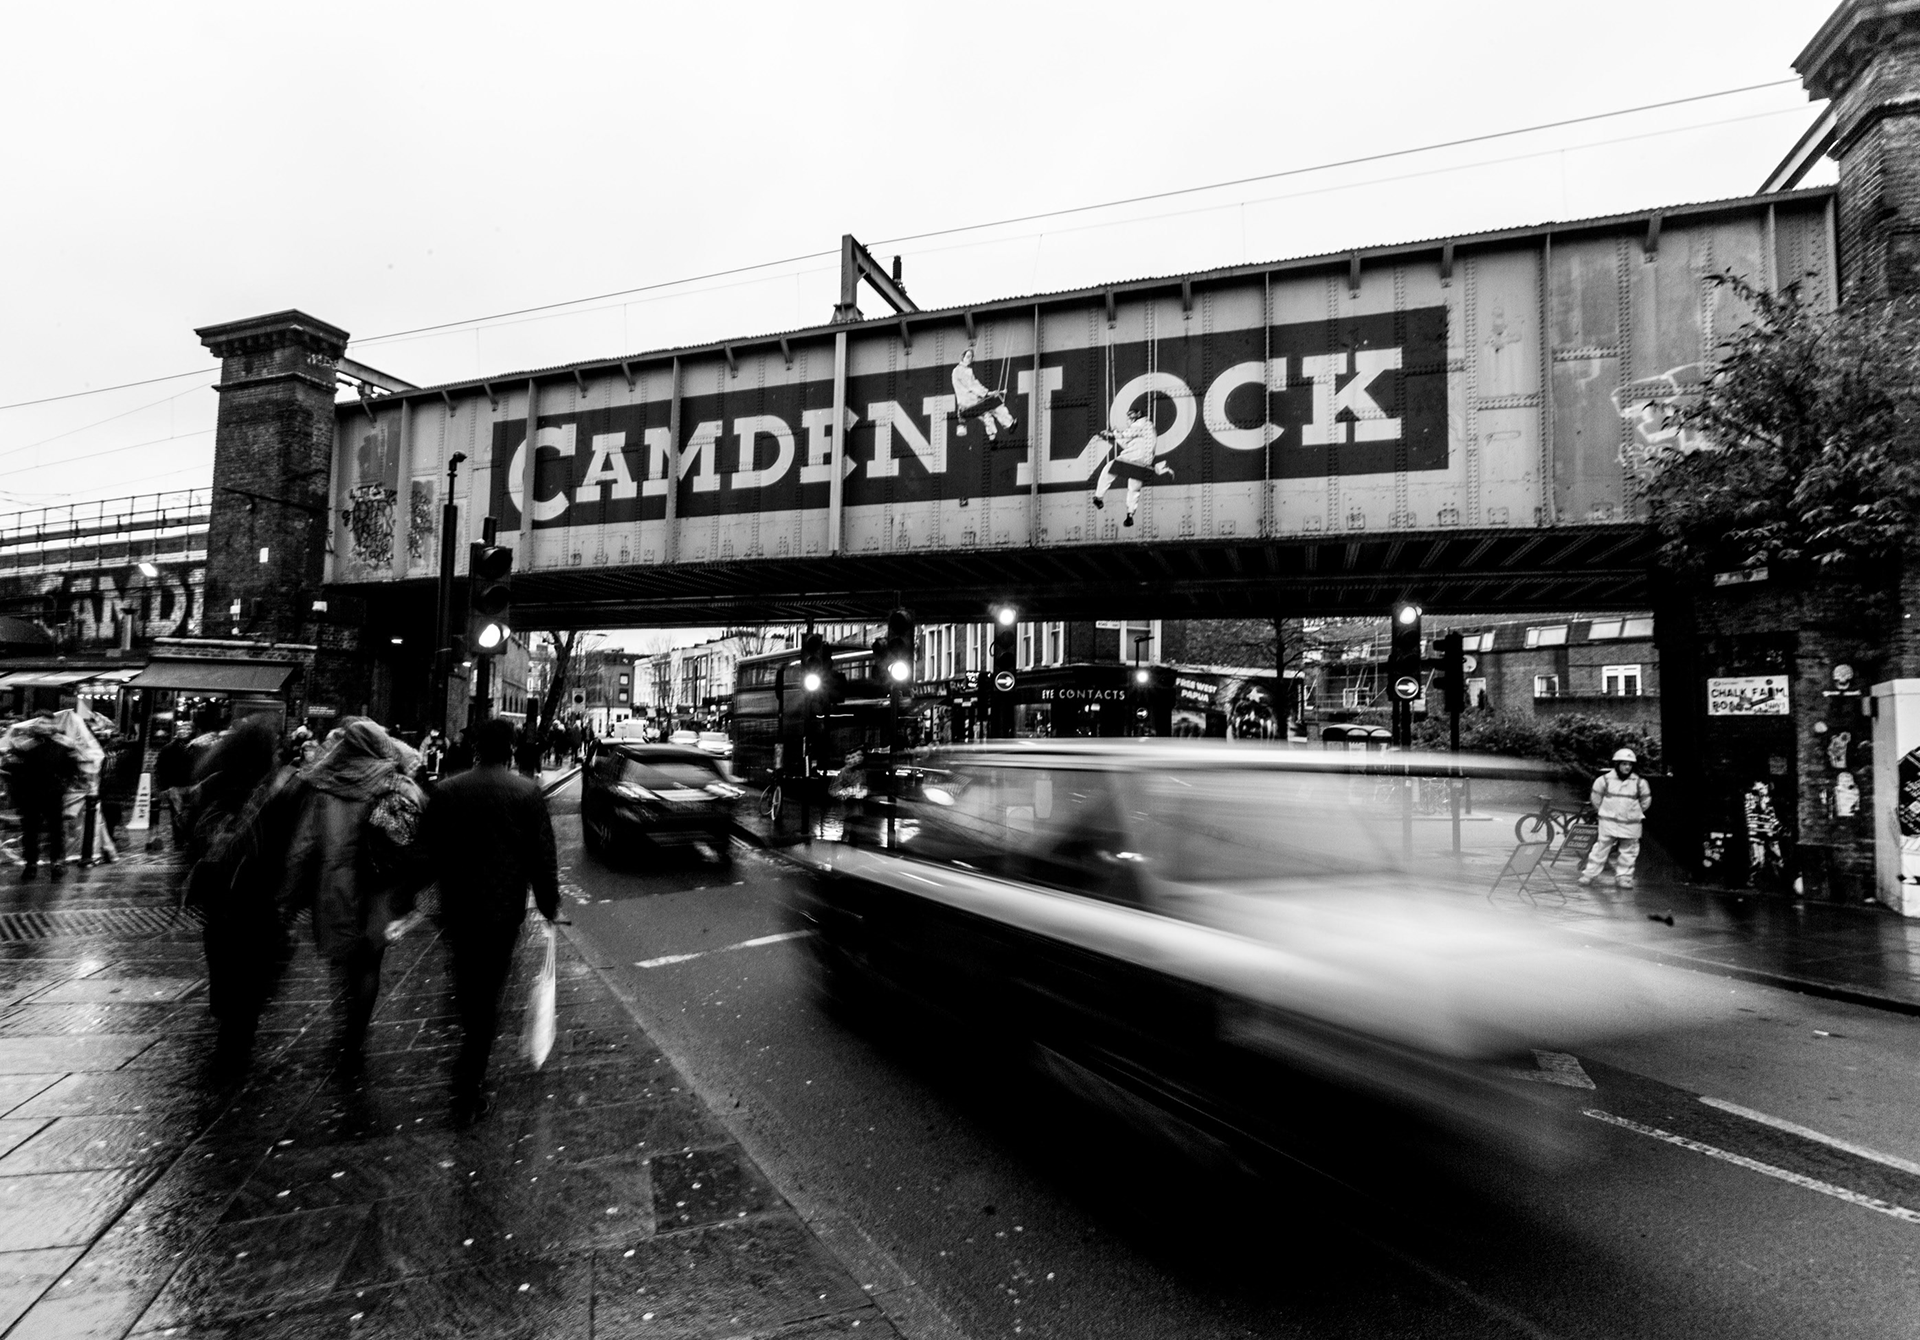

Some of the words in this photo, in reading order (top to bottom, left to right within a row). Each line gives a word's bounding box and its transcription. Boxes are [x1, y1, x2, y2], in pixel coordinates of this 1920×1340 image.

[508, 395, 957, 521] CAMDEN
[1017, 347, 1403, 486] LOCK
[1175, 677, 1195, 689] FREE
[1196, 681, 1218, 694] WEST
[1042, 689, 1054, 700] EYE
[1058, 688, 1126, 701] CONTACTS
[1180, 689, 1209, 702] PAPUA
[1711, 687, 1747, 698] CHALK
[1752, 687, 1786, 698] FAM
